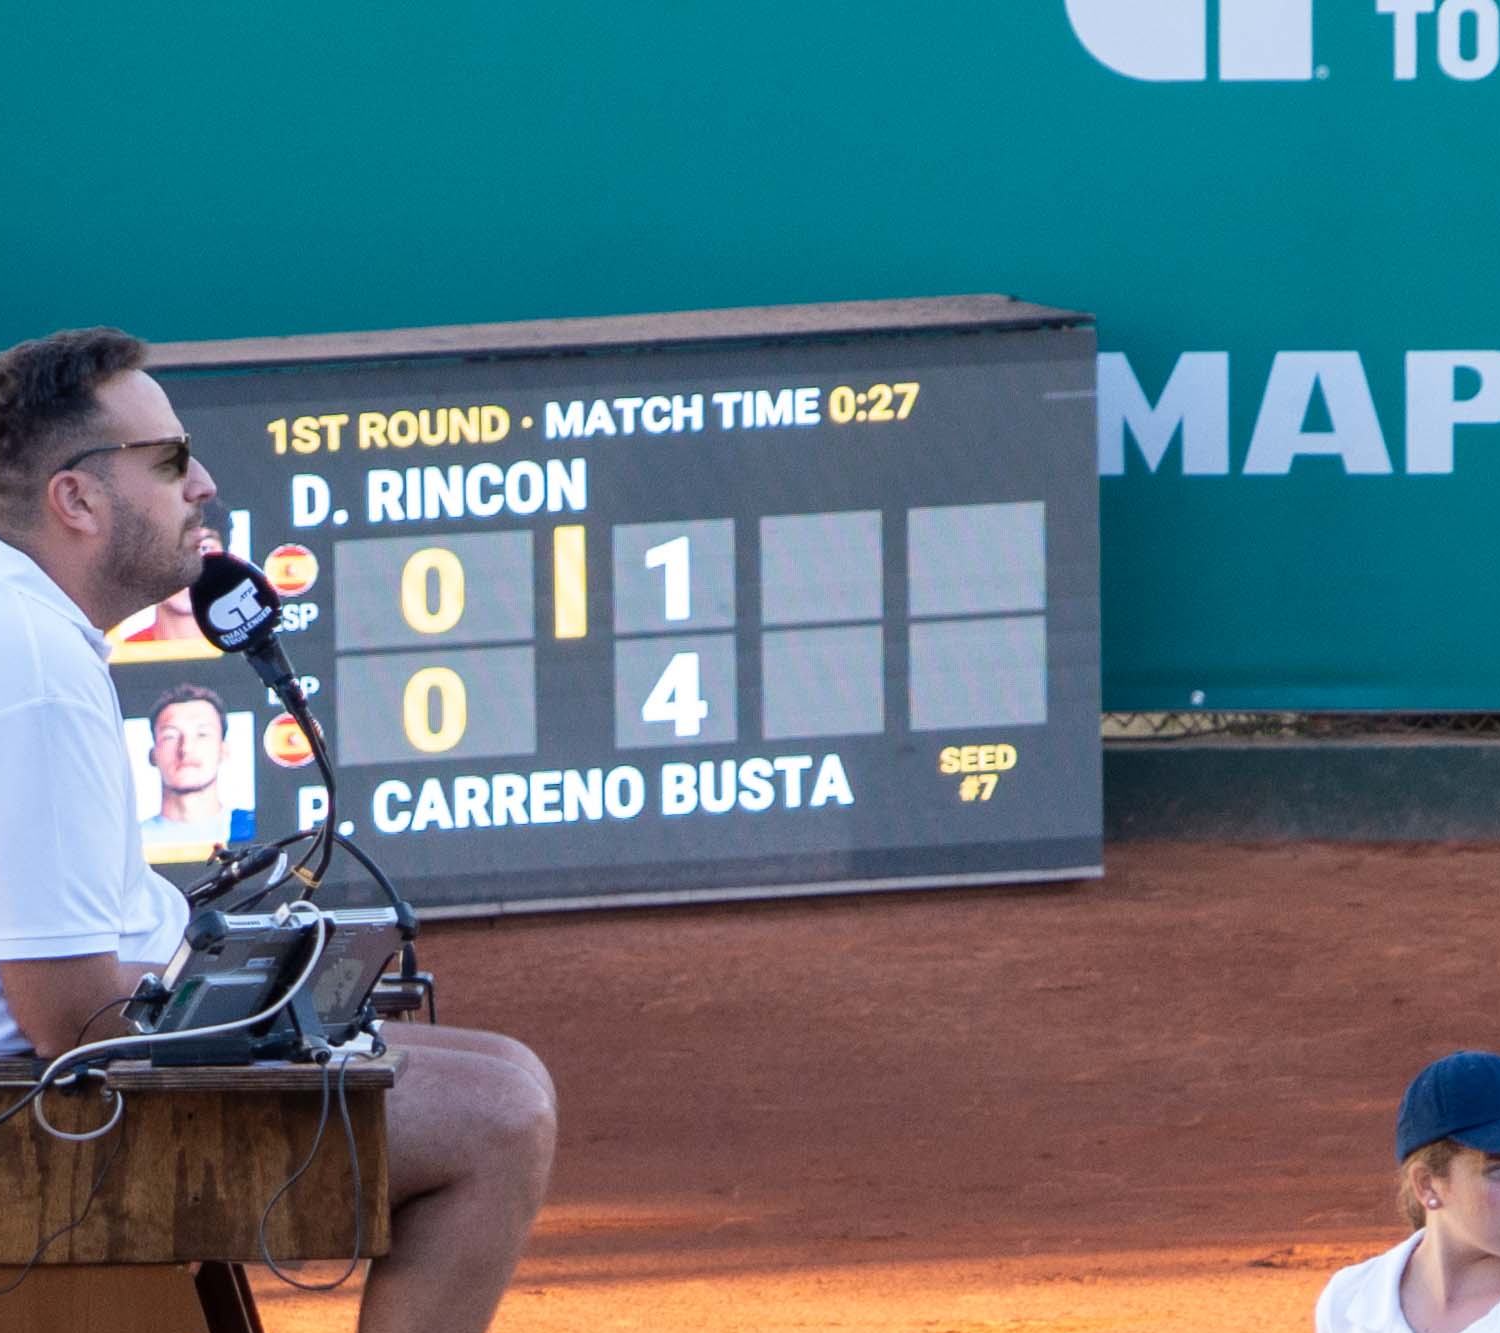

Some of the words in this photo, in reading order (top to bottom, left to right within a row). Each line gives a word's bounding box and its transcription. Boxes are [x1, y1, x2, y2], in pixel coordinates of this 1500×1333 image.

[266, 414, 348, 455] 1ST
[359, 405, 510, 449] ROUND
[543, 393, 704, 440] MATCH
[712, 387, 821, 428] TIME
[828, 382, 920, 424] 0:27
[291, 473, 349, 527] D.
[366, 457, 588, 523] RINCON
[401, 547, 466, 634] 0
[643, 536, 692, 622] 1
[403, 666, 468, 754] 0
[642, 651, 708, 737] 4
[371, 766, 645, 835] CARRENO
[661, 754, 855, 815] BUSTA
[939, 743, 1017, 774] SEED
